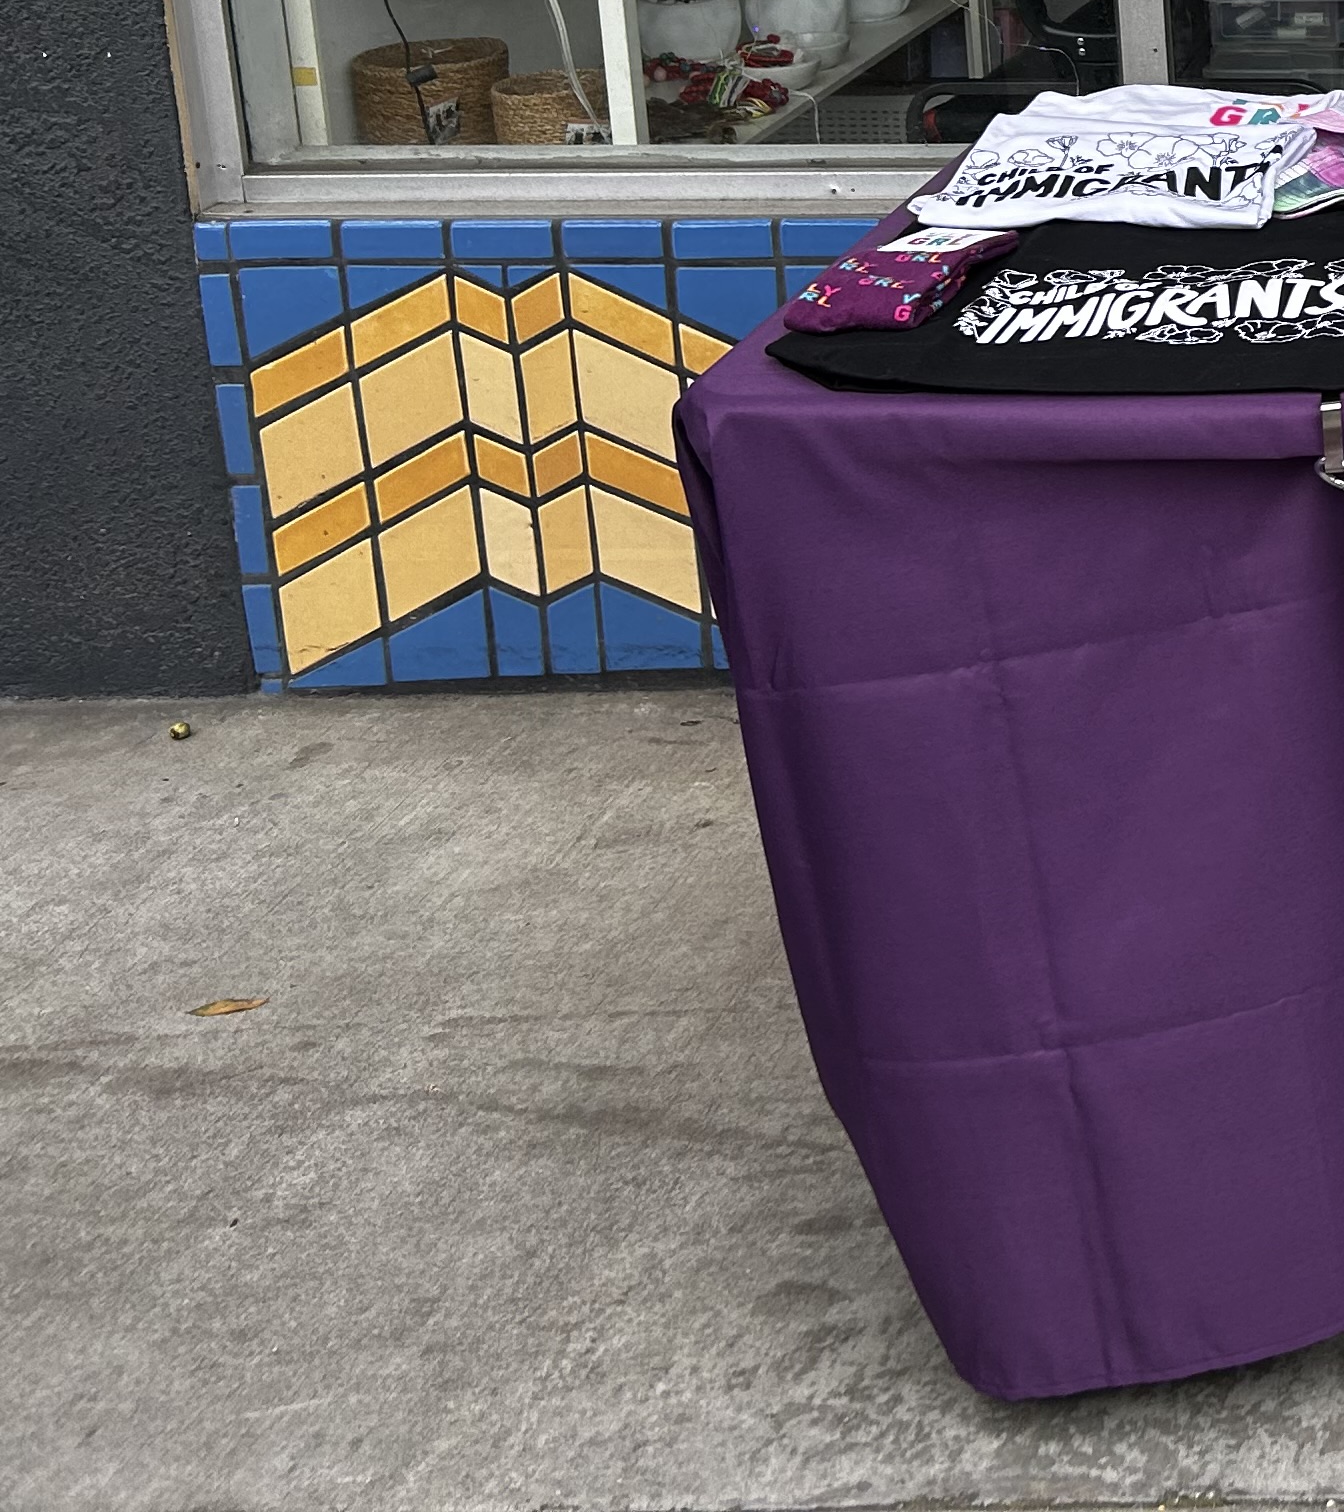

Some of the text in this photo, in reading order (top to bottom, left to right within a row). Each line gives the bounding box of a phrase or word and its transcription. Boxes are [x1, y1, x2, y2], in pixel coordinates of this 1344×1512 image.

[908, 237, 965, 247] GRL
[894, 252, 942, 264] GRL
[1007, 282, 1100, 305] CHILD
